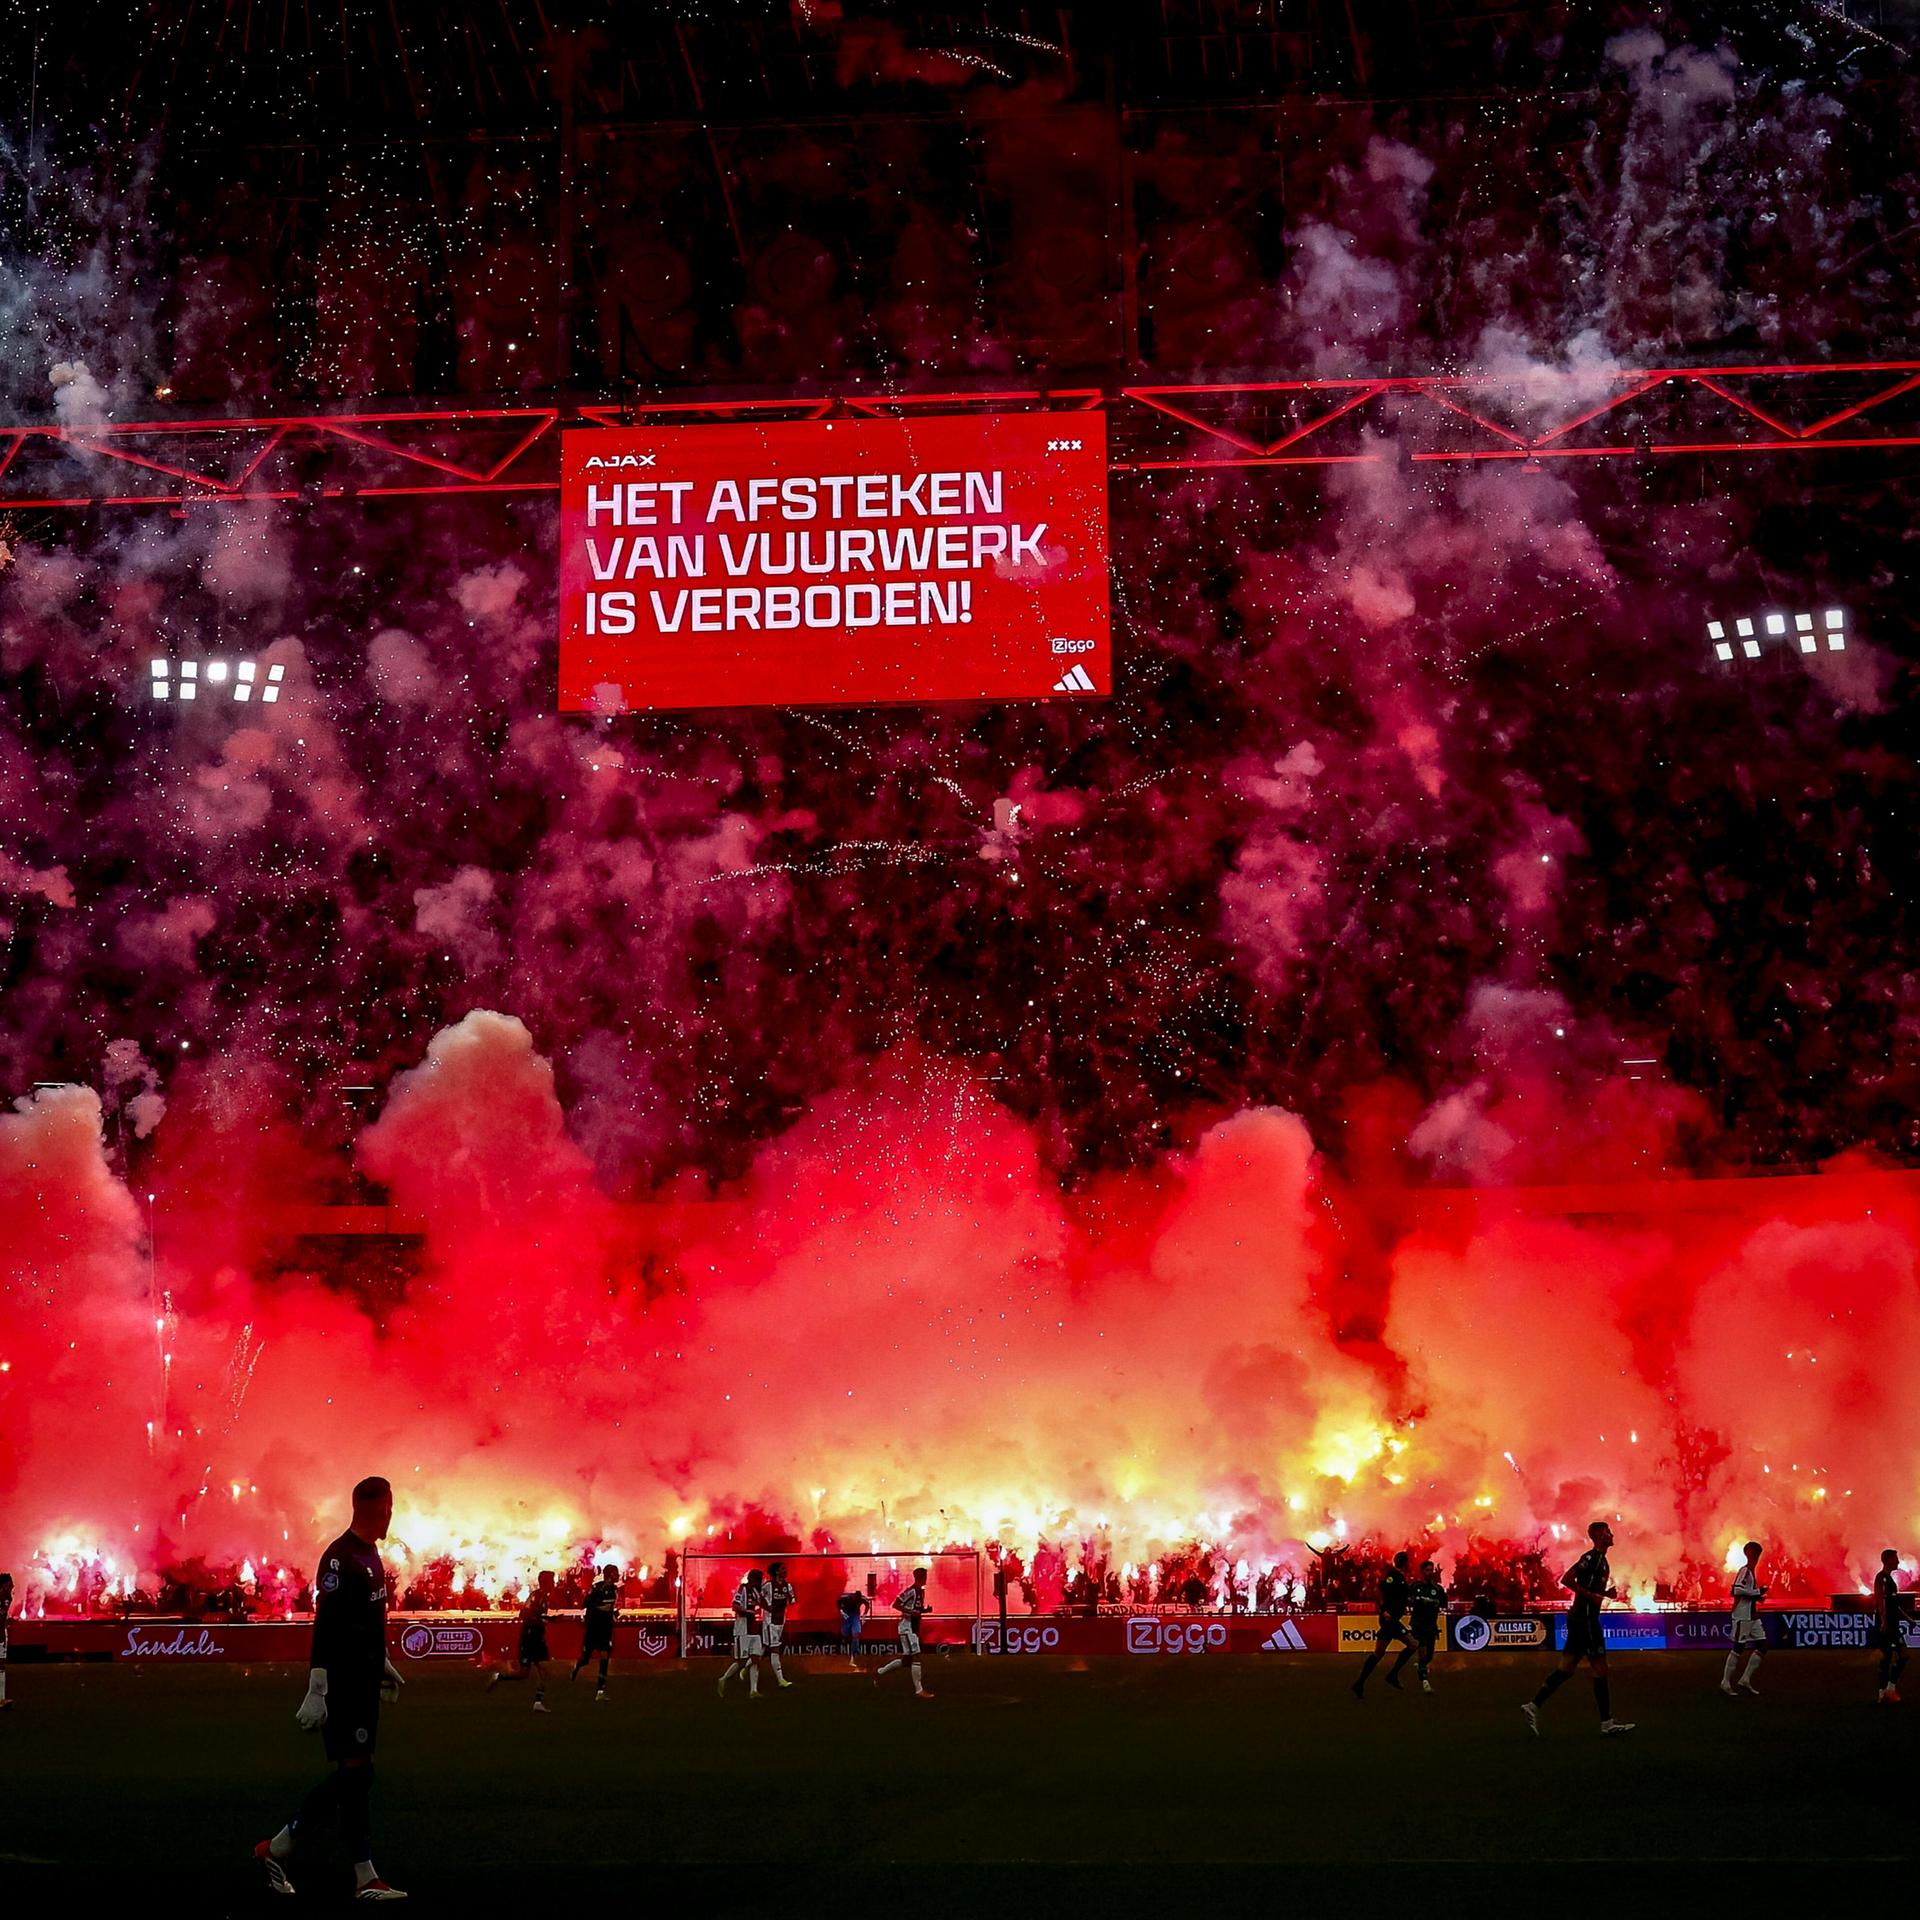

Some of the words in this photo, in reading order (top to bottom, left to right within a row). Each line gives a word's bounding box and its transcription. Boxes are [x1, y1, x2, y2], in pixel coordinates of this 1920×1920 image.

[585, 454, 657, 468] AJAX
[587, 481, 694, 527] HET
[706, 470, 1003, 523] AFSTEKEN
[585, 534, 704, 580] VAN
[718, 523, 1048, 578] VUURWERK
[585, 590, 636, 635] IS
[650, 580, 973, 633] VERBODEN!
[1498, 1622, 1533, 1633] ALLSAFE
[1782, 1613, 1876, 1629] VRIENDEN
[121, 1627, 225, 1656] Sandals
[1795, 1629, 1867, 1647] LOTERIJ
[783, 1643, 838, 1657] ALLSAFE
